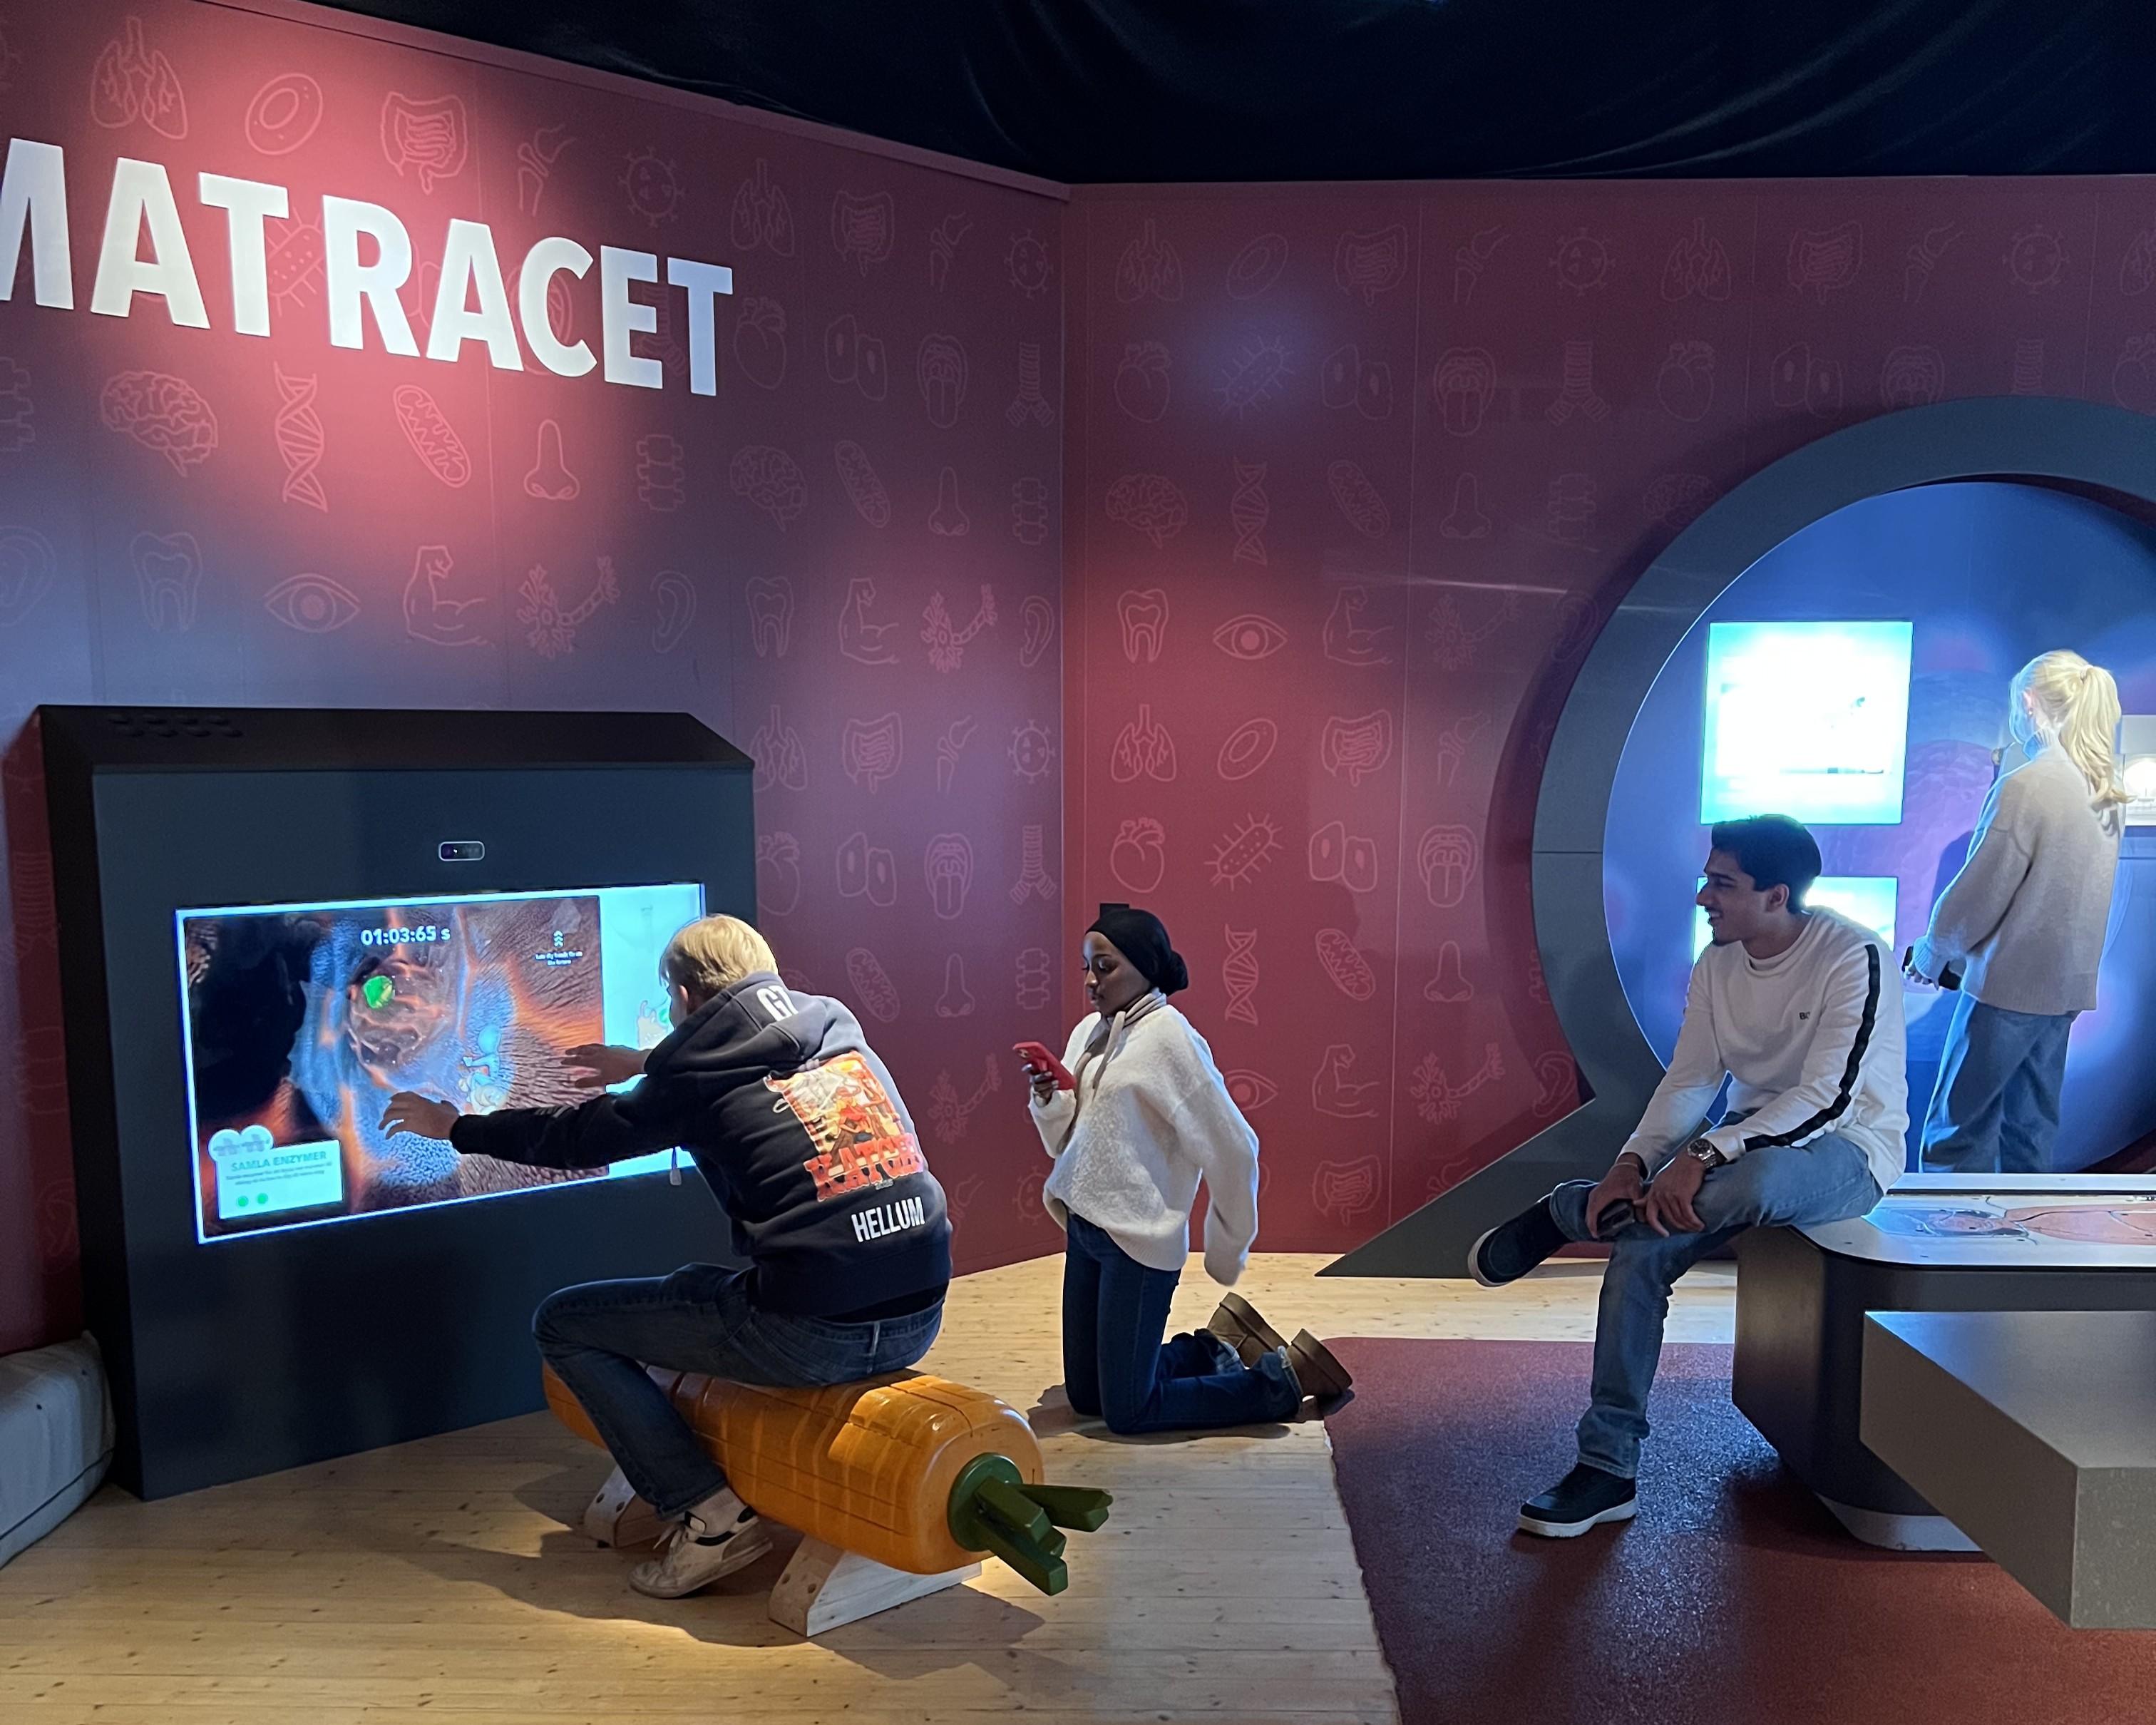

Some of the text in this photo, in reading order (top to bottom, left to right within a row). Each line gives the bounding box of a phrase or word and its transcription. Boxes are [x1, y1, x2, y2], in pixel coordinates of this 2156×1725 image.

[360, 925, 451, 946] 01:03:65 s
[273, 1150, 327, 1166] ENZYMER
[851, 1196, 925, 1242] HELLUM
